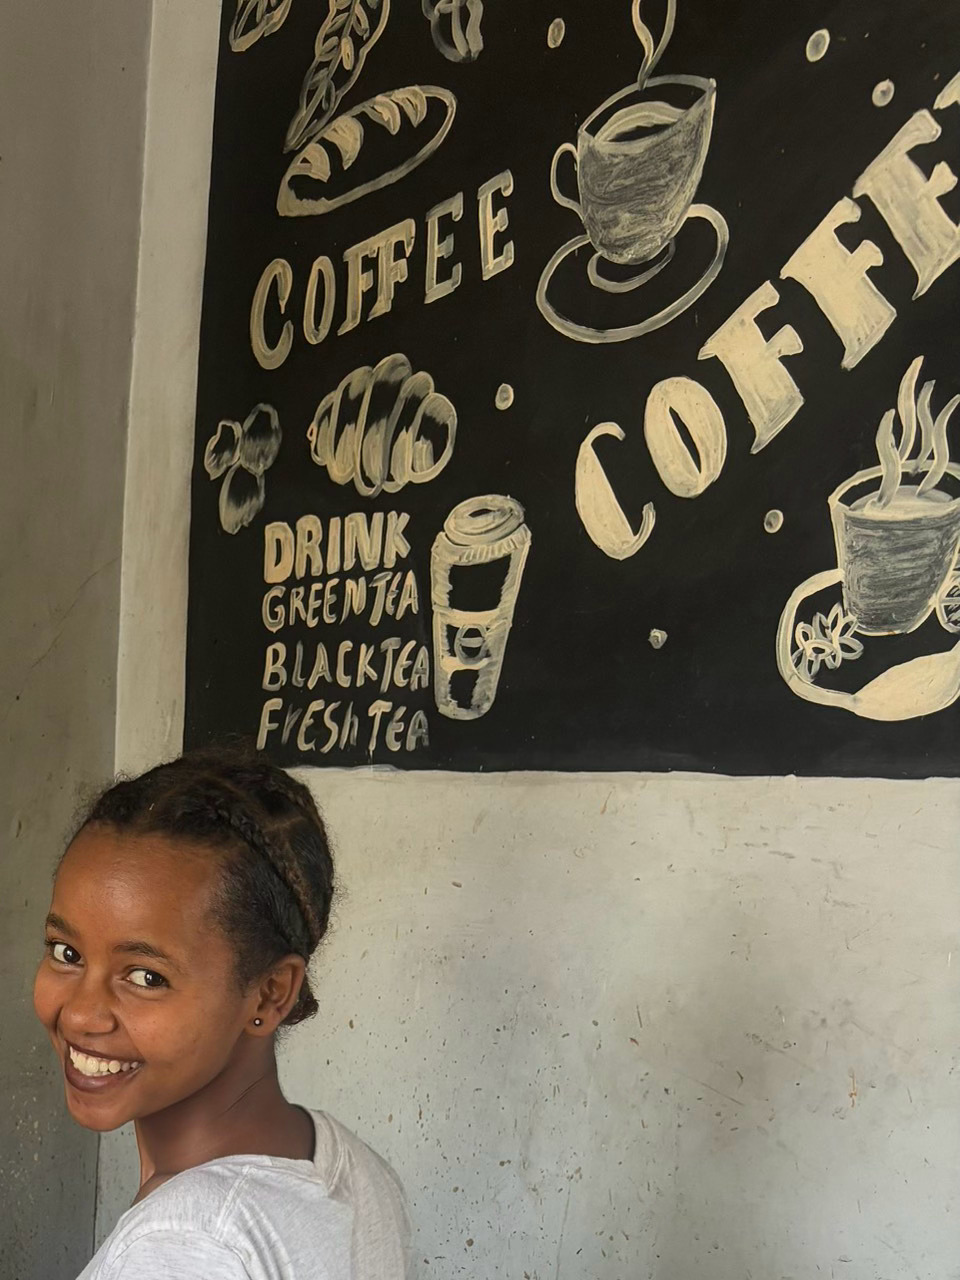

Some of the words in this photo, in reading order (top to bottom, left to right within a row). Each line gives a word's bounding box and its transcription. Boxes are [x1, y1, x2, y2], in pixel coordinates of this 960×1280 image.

[250, 170, 515, 369] COFFEE
[264, 511, 411, 583] DRINK
[368, 699, 429, 752] TEA
